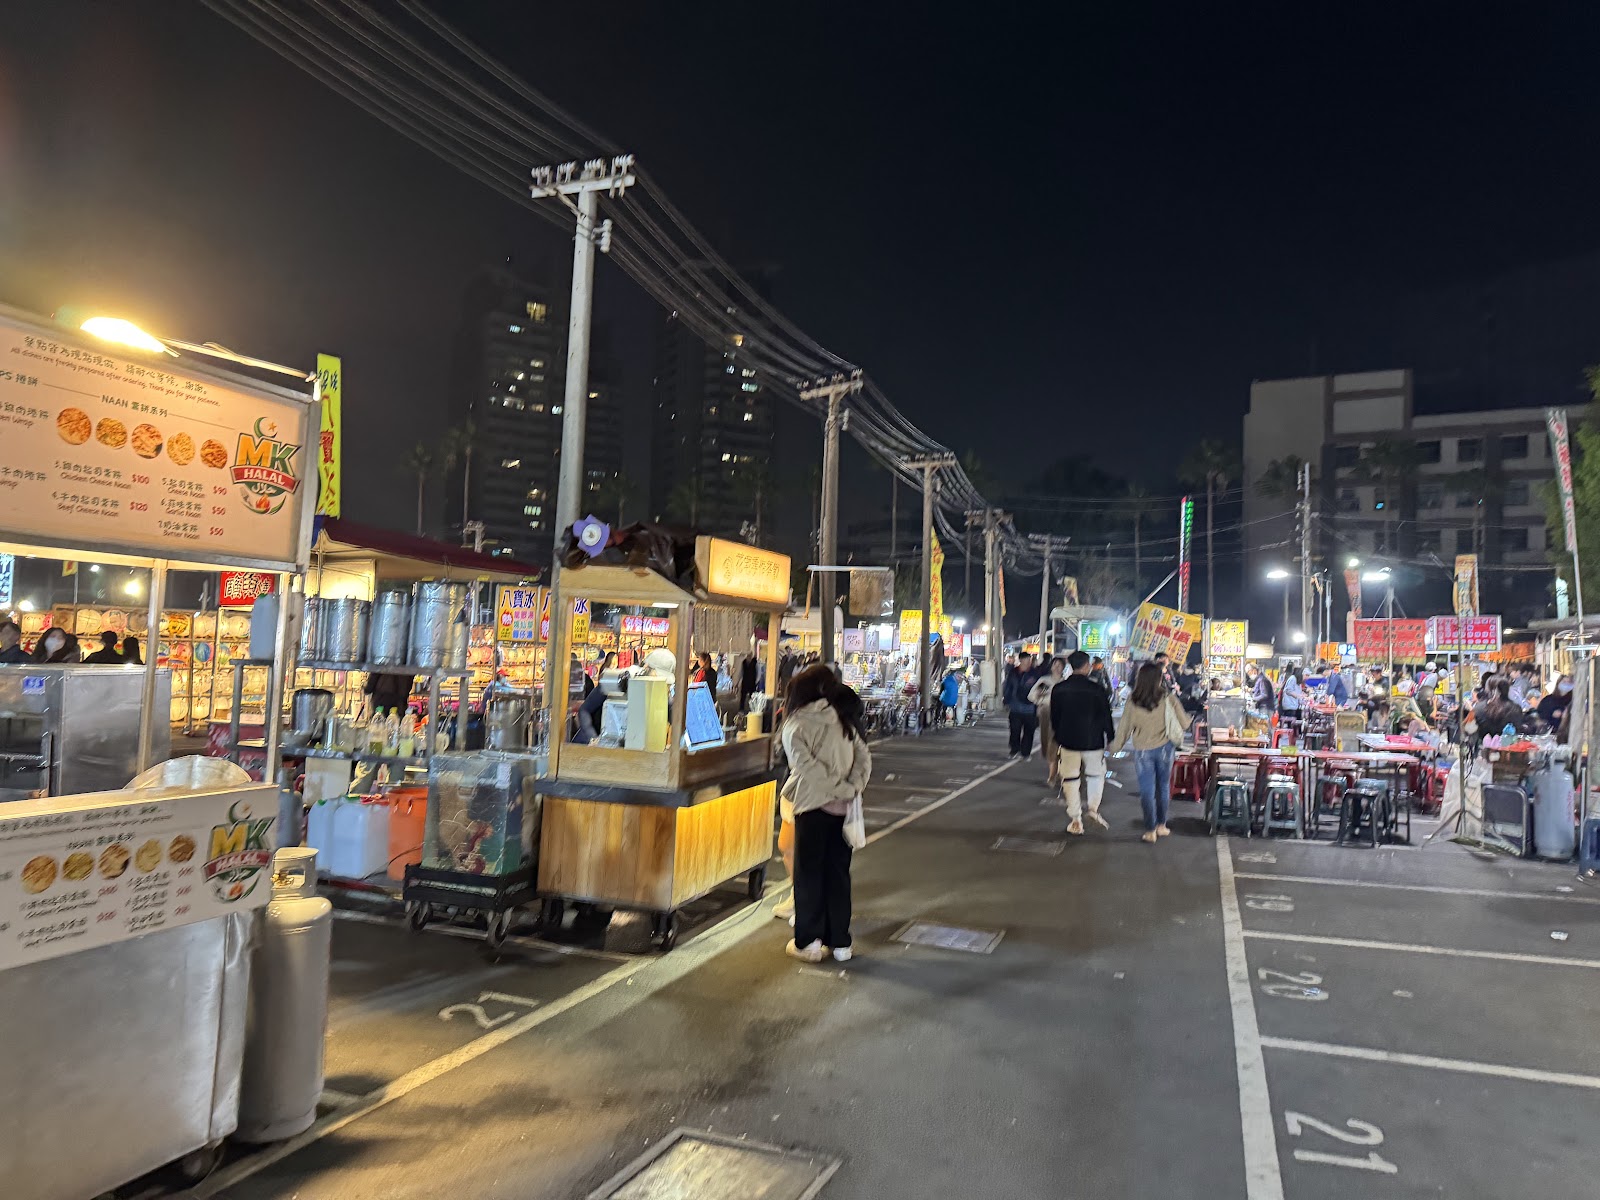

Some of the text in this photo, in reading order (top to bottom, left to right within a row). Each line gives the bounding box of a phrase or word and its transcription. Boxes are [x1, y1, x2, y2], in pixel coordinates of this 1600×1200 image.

[101, 394, 128, 408] NAAN
[235, 433, 301, 476] MK
[131, 473, 150, 485] $100
[243, 468, 286, 486] HALAL
[213, 485, 227, 496] $90
[129, 501, 148, 512] $120
[212, 505, 226, 516] $50
[209, 526, 224, 537] $50
[501, 589, 536, 609] 八寶冰
[209, 817, 276, 860] MK
[1284, 1110, 1398, 1174] 21
